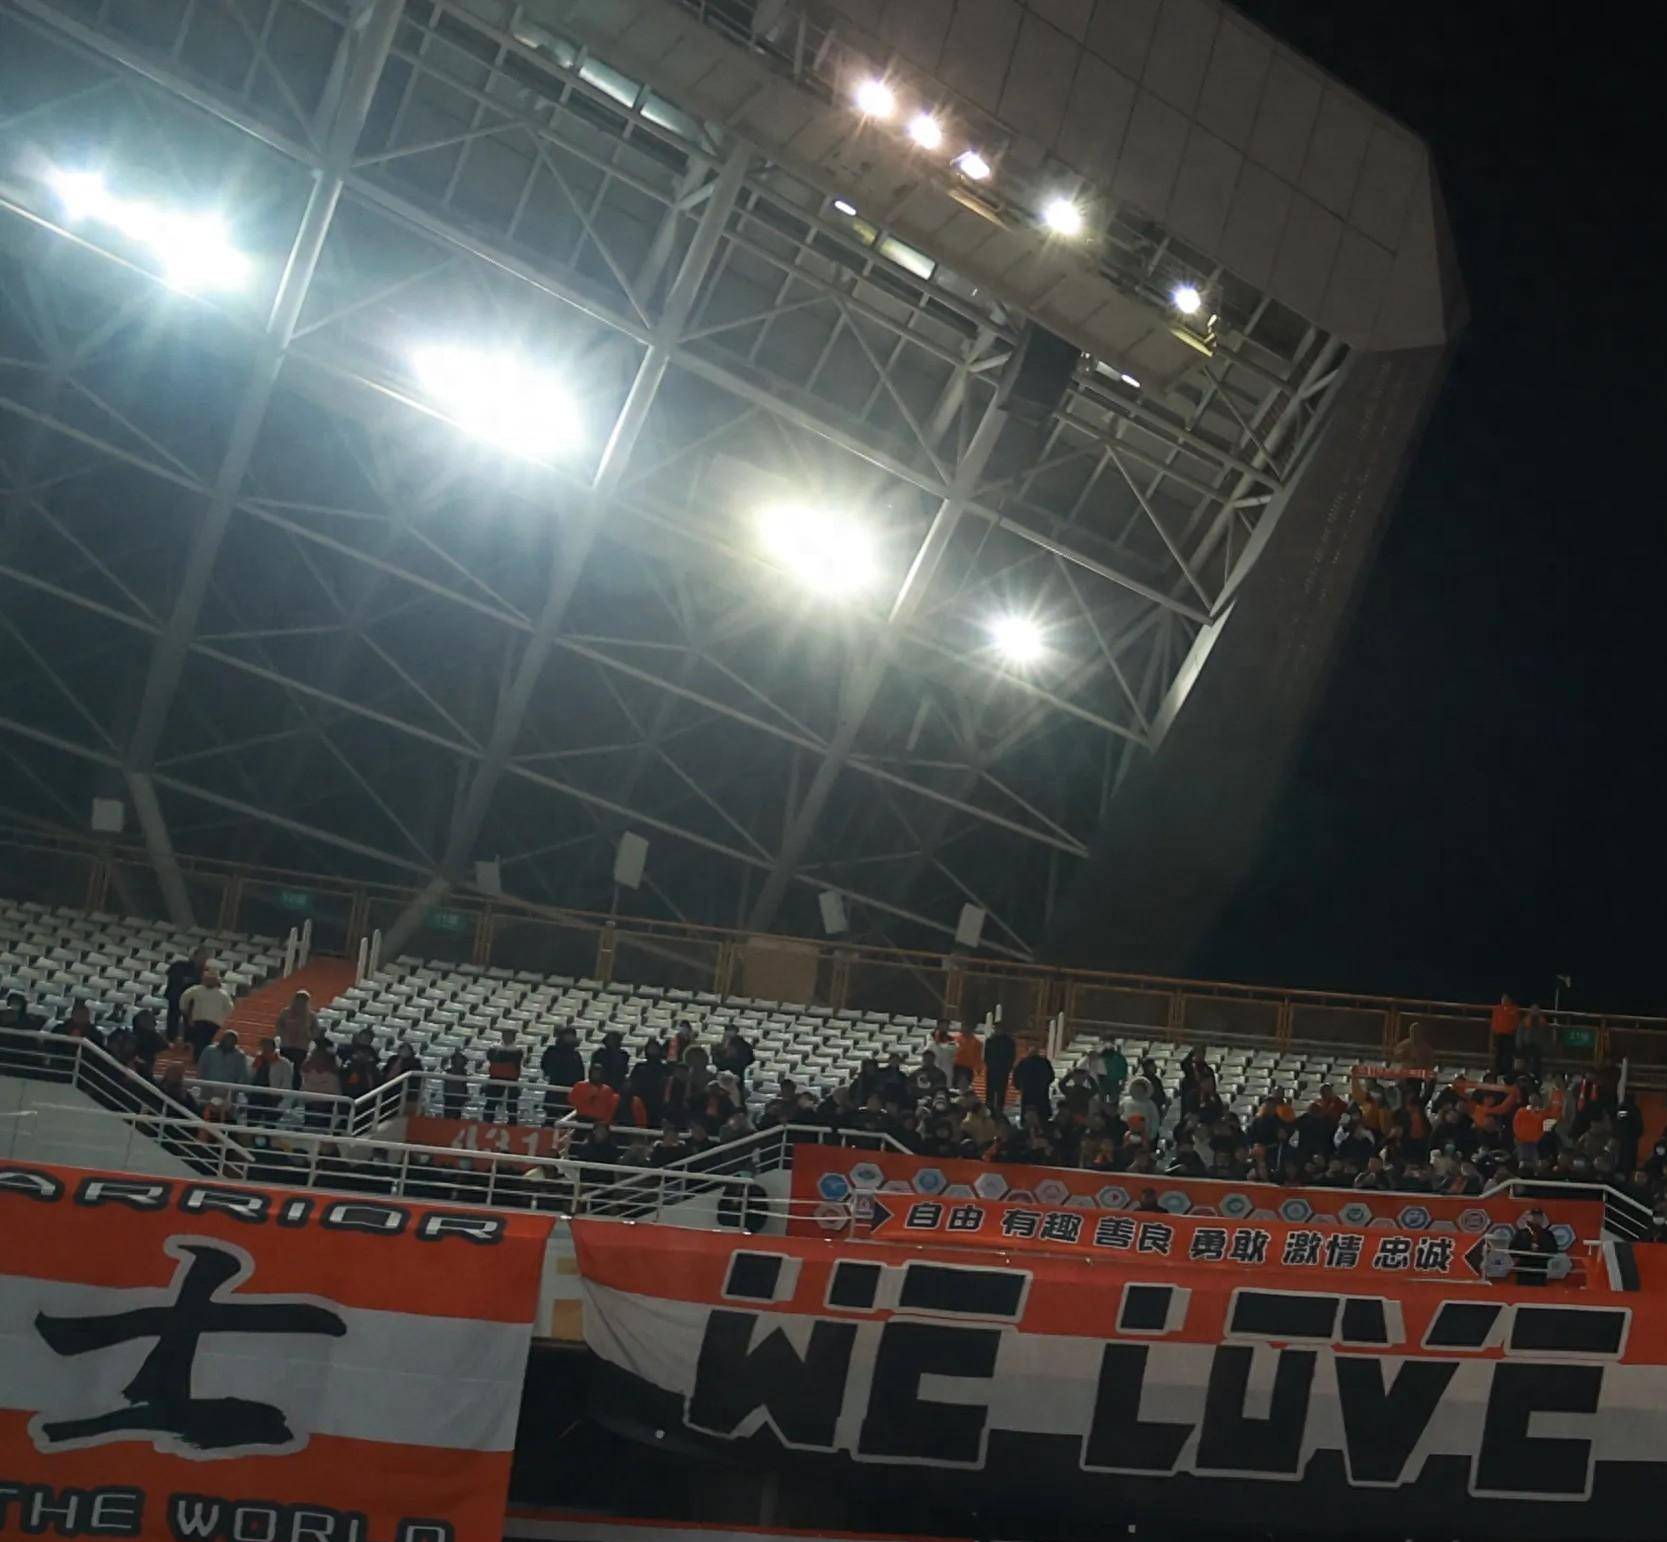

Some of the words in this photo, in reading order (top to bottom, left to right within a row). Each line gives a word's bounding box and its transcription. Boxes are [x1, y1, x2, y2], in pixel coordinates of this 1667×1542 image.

[34, 1236, 348, 1452] 士
[903, 1201, 984, 1233] 自由
[1002, 1208, 1083, 1247] 有趣
[1094, 1215, 1174, 1256] 善良
[1189, 1224, 1270, 1264] 勇敢
[1282, 1229, 1362, 1270] 激情
[1373, 1236, 1455, 1275] 忠诚
[1080, 1282, 1633, 1502] LOVE
